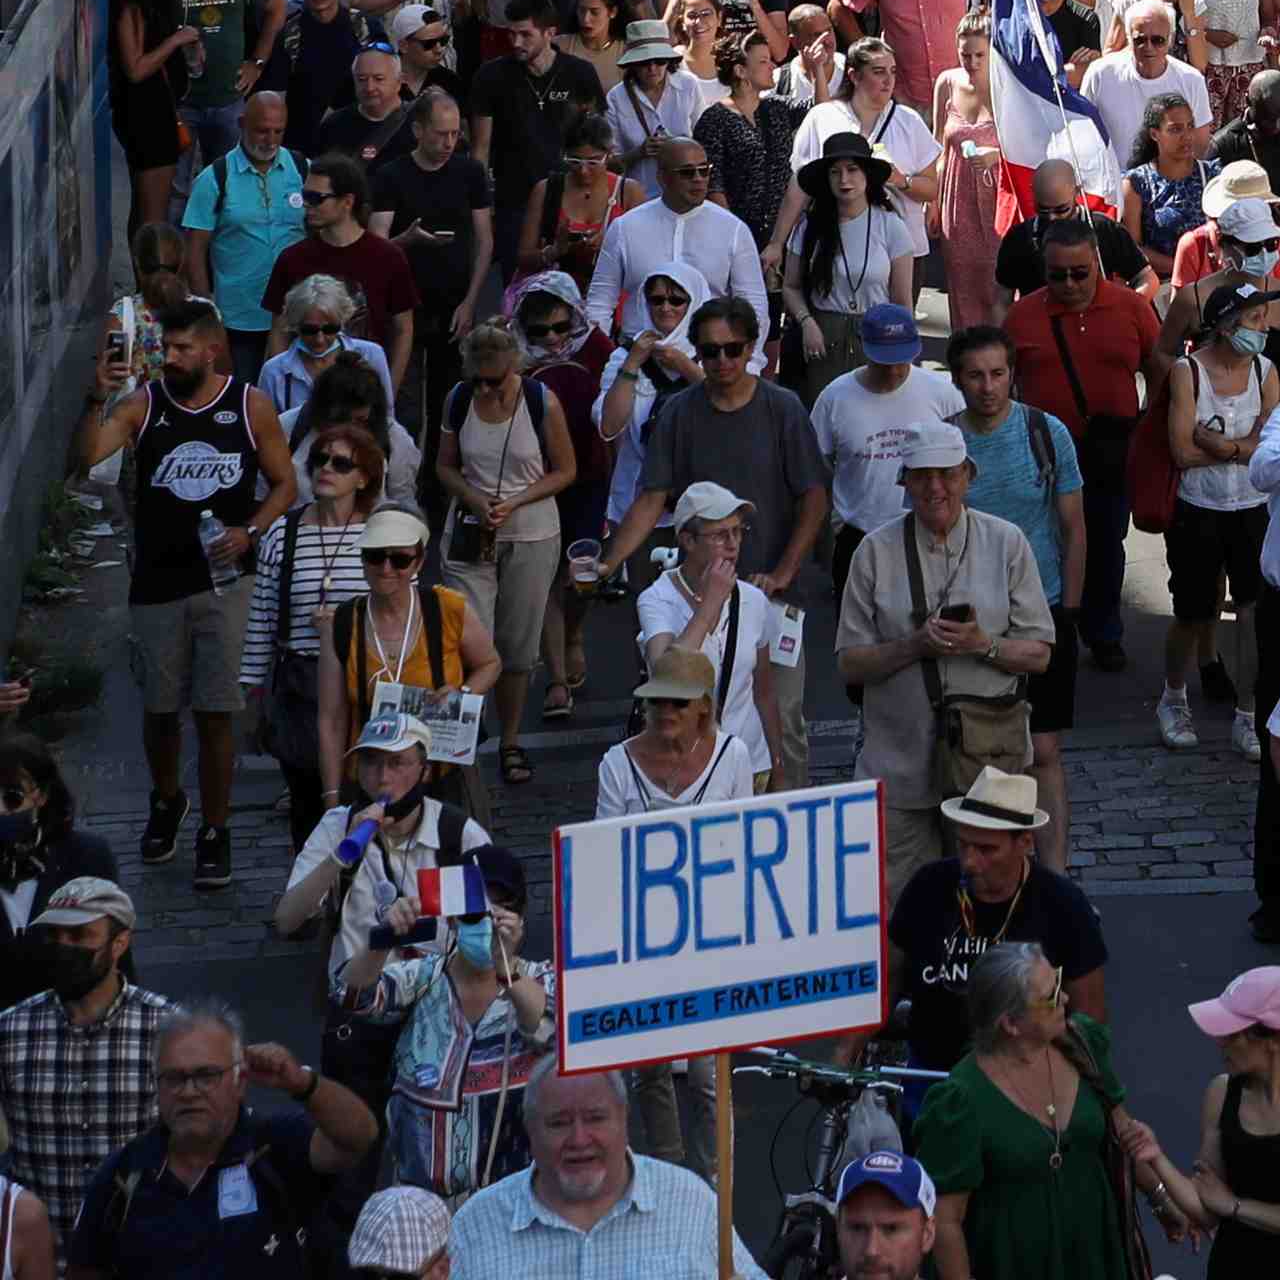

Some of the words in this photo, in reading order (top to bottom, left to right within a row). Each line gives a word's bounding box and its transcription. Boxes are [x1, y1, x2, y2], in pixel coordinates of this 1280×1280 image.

[158, 457, 238, 486] LAKERS
[560, 790, 880, 970] LIBERTE
[922, 963, 968, 984] CAN
[580, 996, 699, 1037] EGALITE
[713, 968, 876, 1013] FRATERNITE
